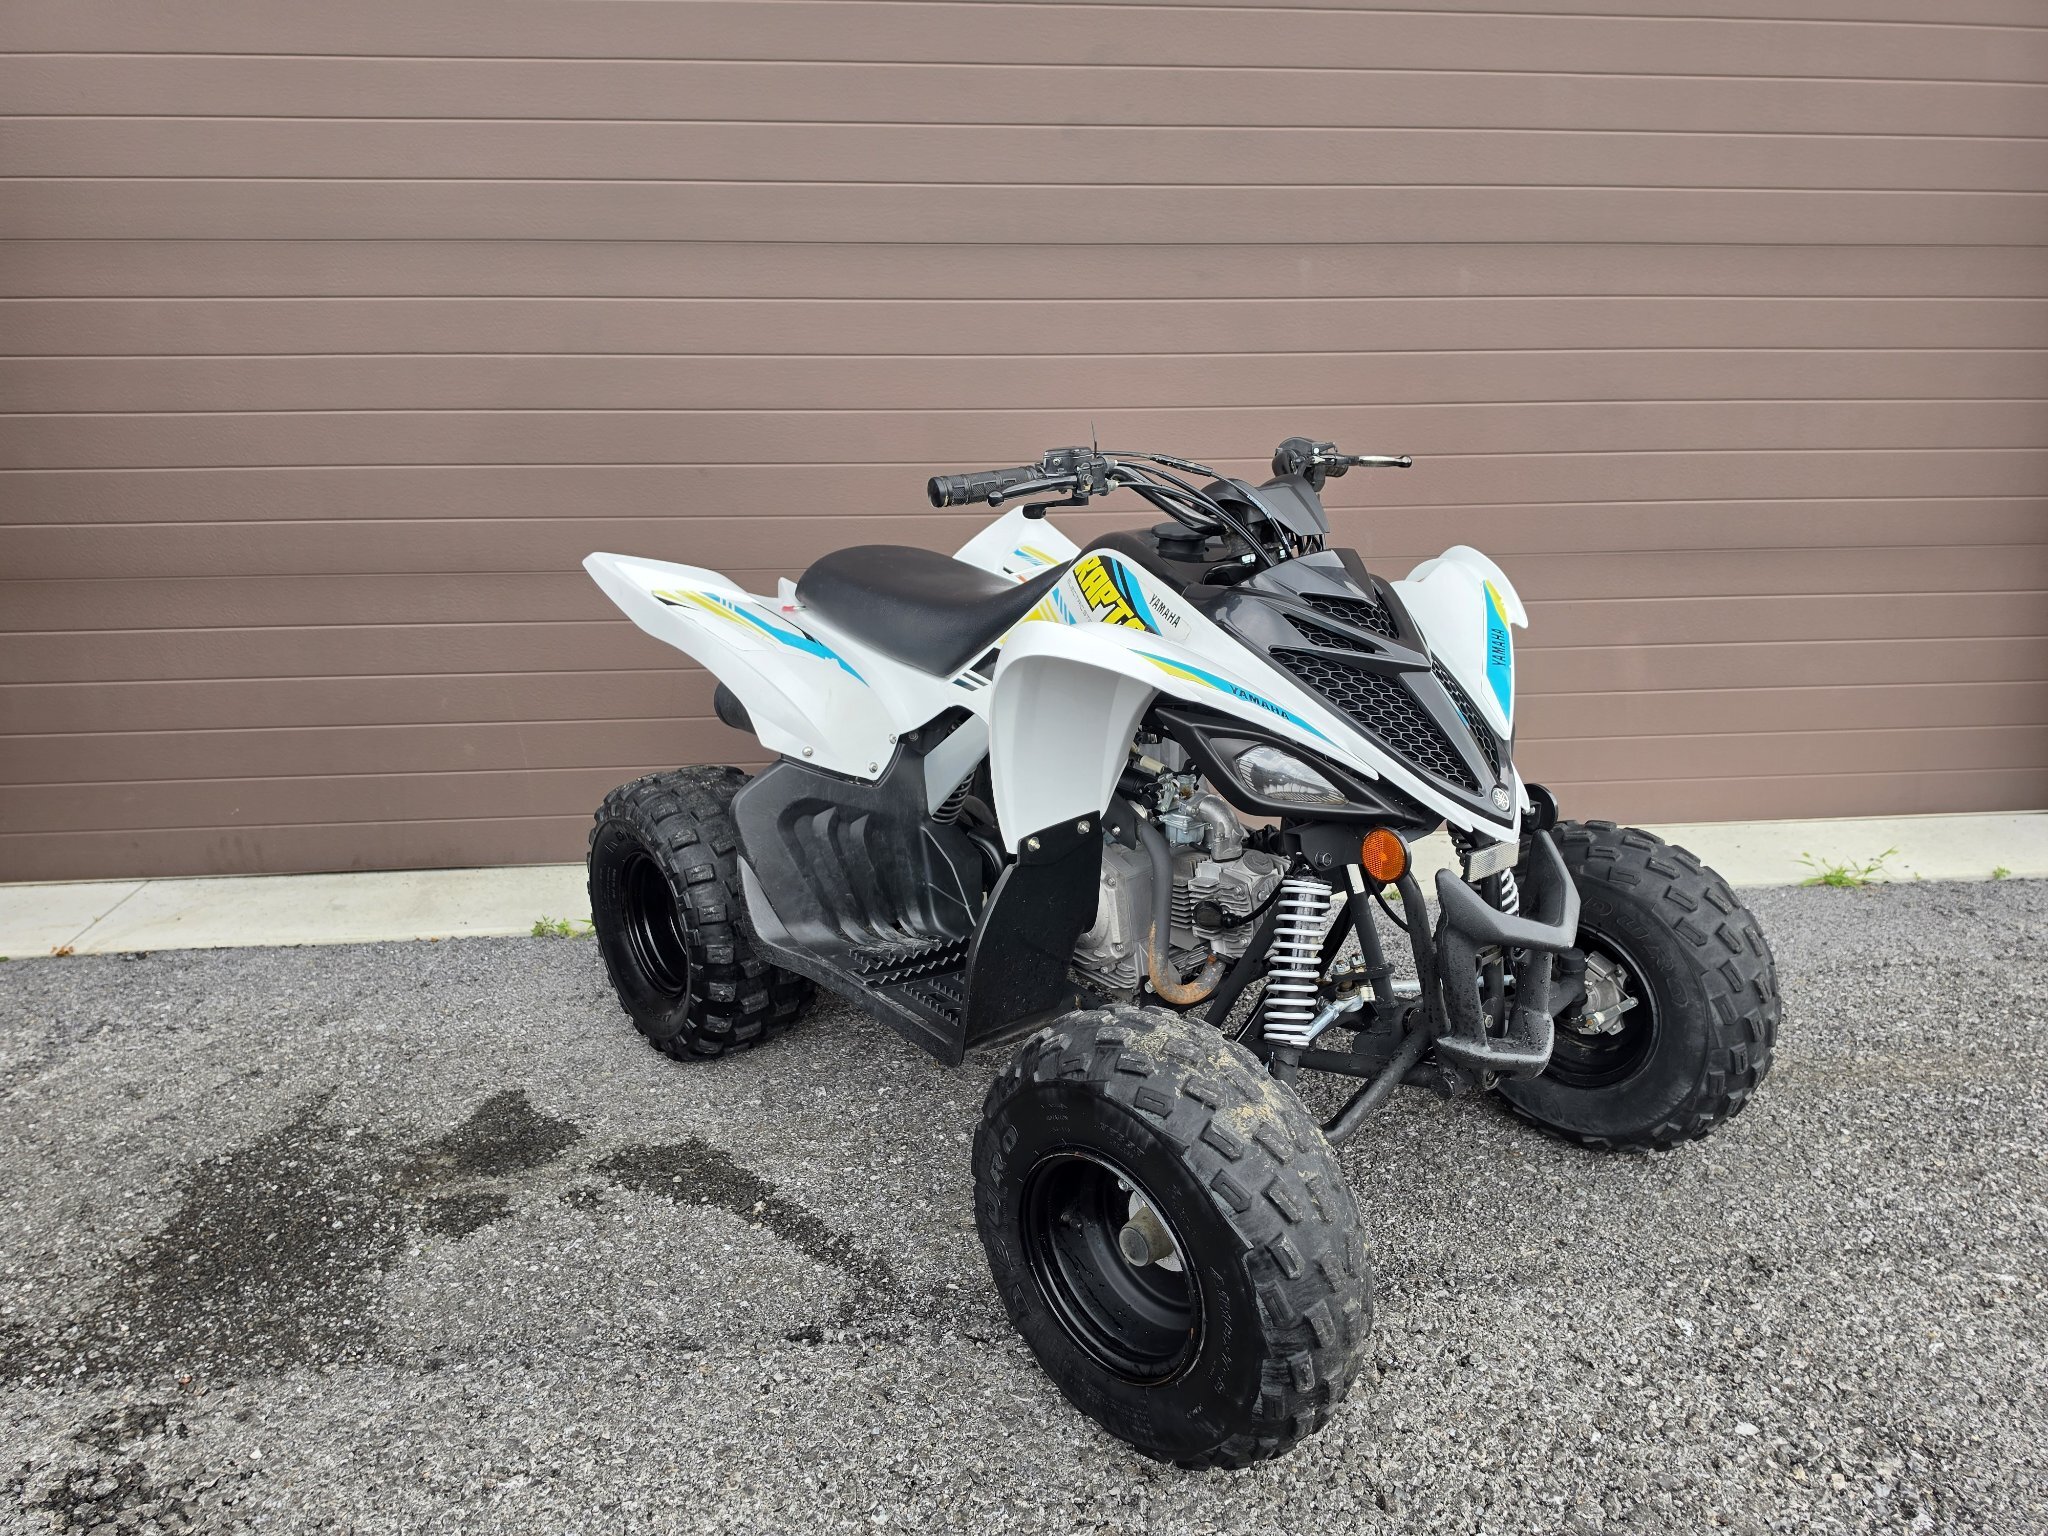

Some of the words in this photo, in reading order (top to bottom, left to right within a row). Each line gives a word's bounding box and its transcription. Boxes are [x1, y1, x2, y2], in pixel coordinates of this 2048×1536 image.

[1149, 593, 1181, 628] YAMAHA
[1491, 628, 1506, 667] YAMAHA
[1230, 684, 1290, 721] YAMAHA
